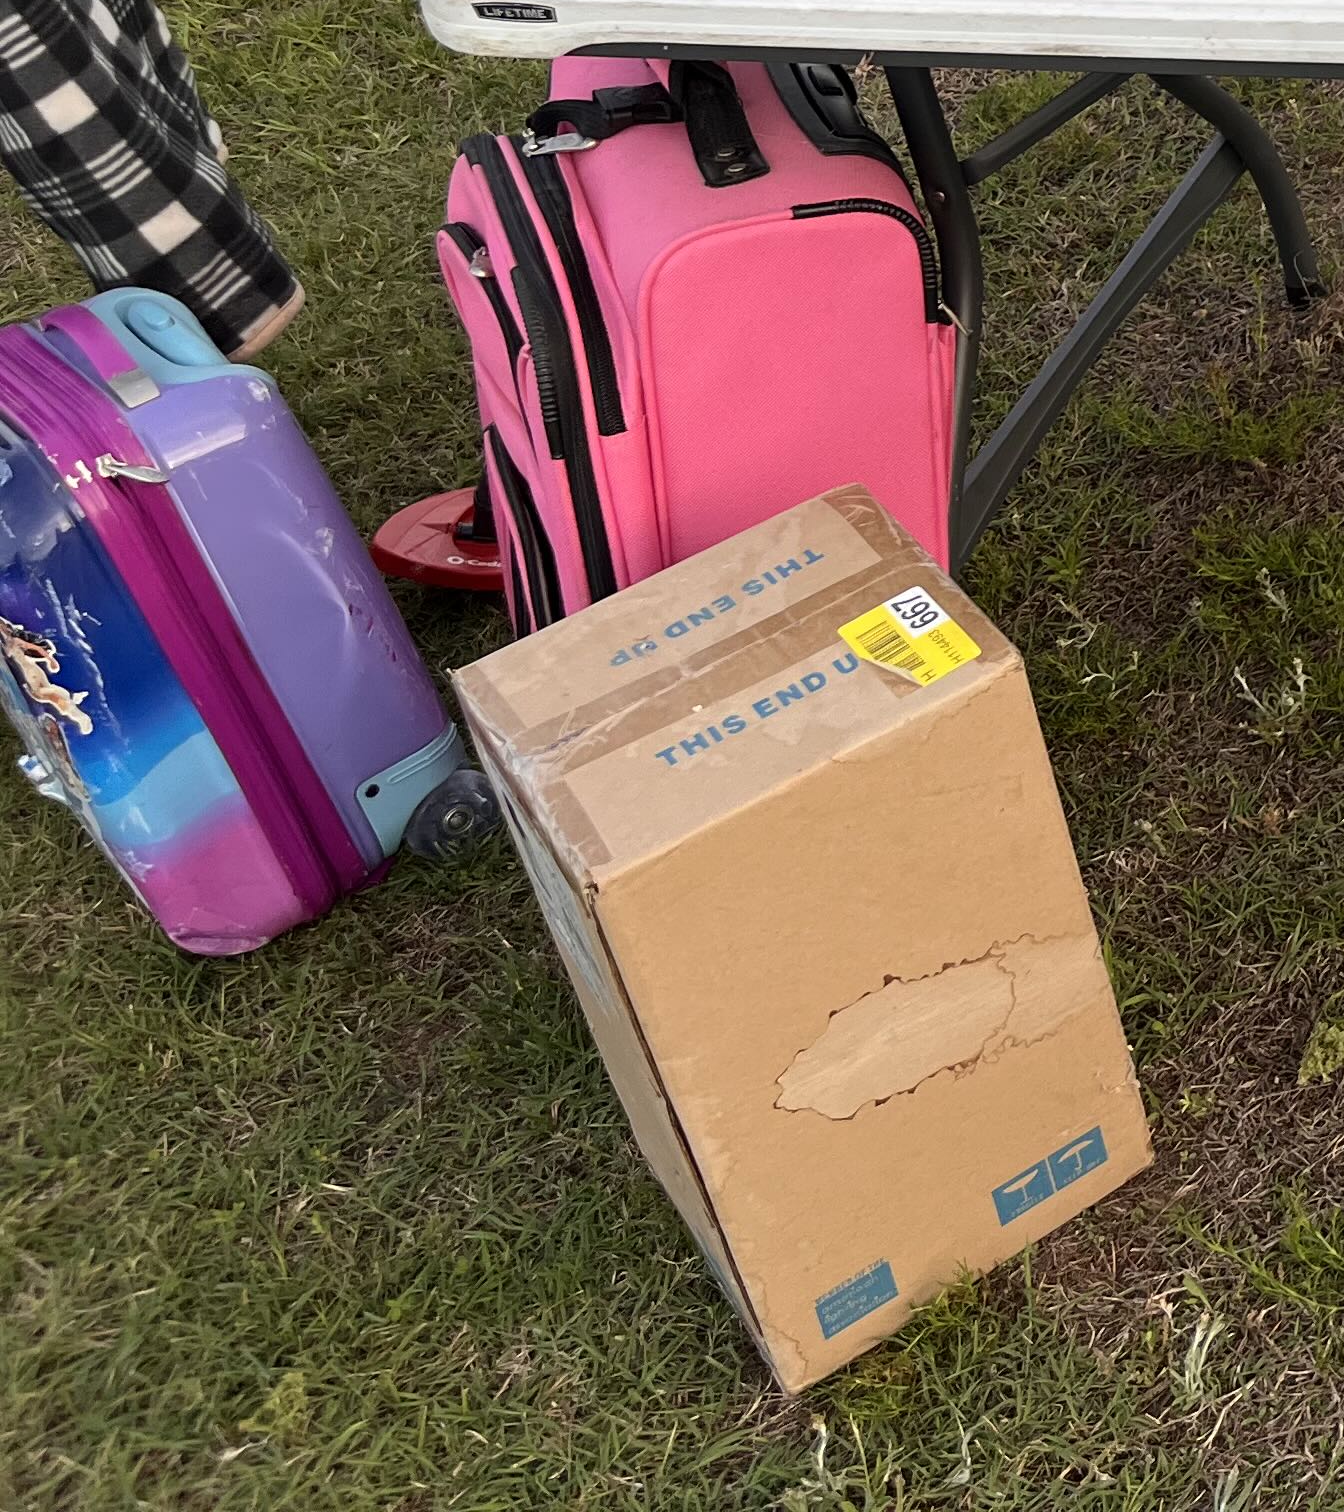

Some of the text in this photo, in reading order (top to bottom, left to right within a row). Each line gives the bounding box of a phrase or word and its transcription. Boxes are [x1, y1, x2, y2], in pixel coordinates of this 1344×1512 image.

[483, 7, 547, 19] LIFETIME
[608, 548, 825, 667] THIS END UP
[891, 595, 938, 629] 667
[920, 668, 937, 683] H
[655, 652, 860, 768] THIS END U
